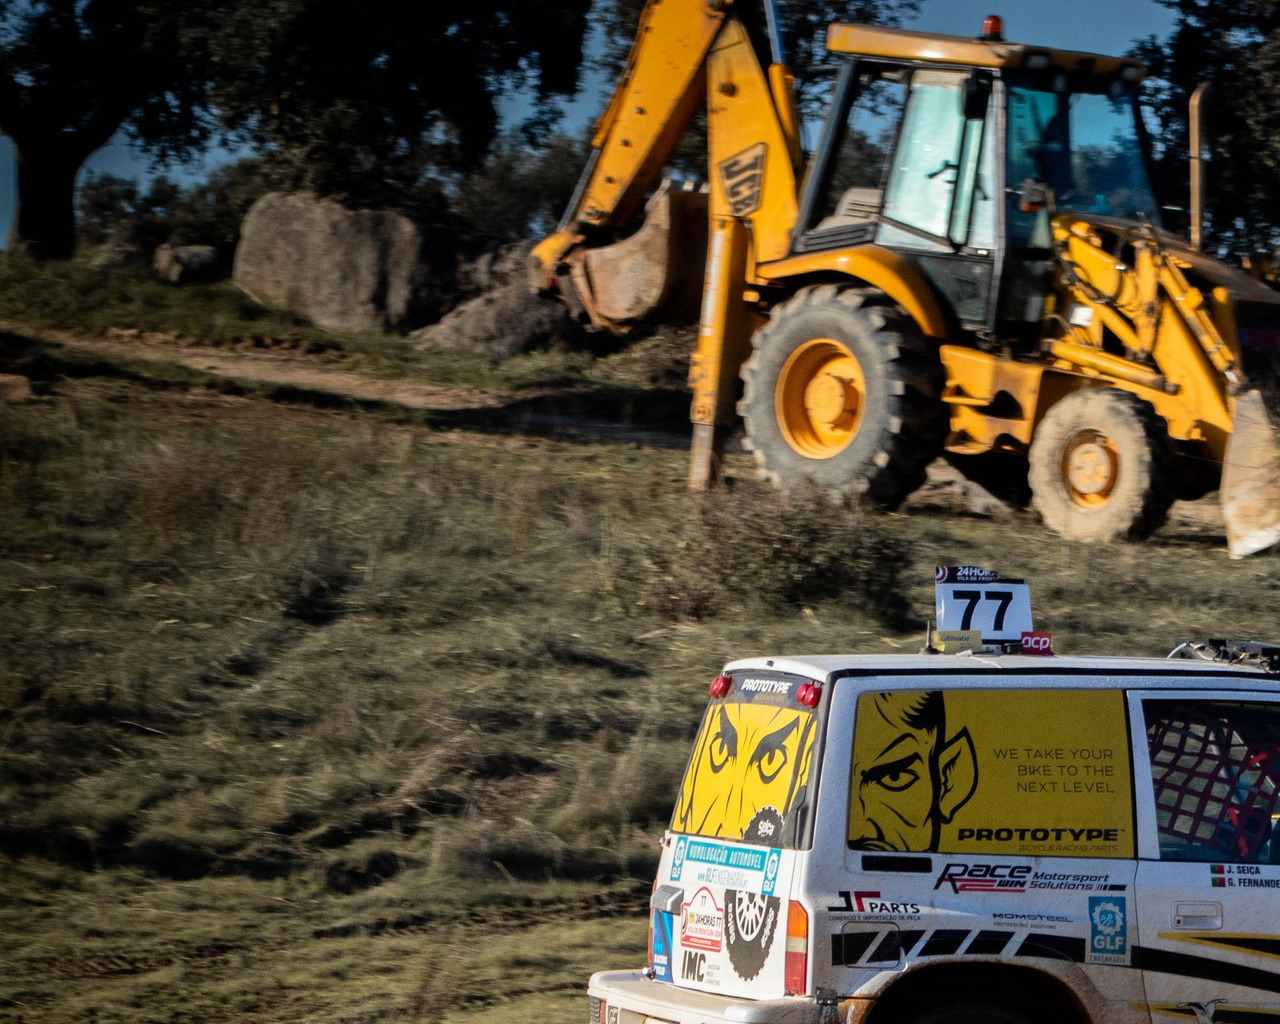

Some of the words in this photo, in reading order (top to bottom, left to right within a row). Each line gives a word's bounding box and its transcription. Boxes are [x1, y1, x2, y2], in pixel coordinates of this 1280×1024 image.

[723, 153, 764, 213] JCB
[953, 590, 1013, 631] 77
[1022, 637, 1050, 650] acp
[741, 678, 790, 694] PROTOTYPE
[993, 749, 1018, 760] WE
[1026, 749, 1064, 760] TAKE
[1071, 749, 1113, 760] YOUR
[1017, 765, 1051, 776] BIKE
[1057, 765, 1078, 776] TO
[1083, 765, 1114, 777] THE
[1017, 782, 1058, 793] NEXT
[1063, 782, 1115, 793] LEVEL
[957, 828, 1119, 842] PROTOTYPE
[1018, 844, 1054, 852] BICYCLE
[671, 866, 682, 878] GLF
[1227, 865, 1234, 874] J.
[1236, 865, 1261, 875] SEIÇA
[1032, 872, 1109, 883] Motorsport
[1228, 878, 1236, 887] G.
[763, 879, 774, 892] GLF
[996, 880, 1027, 888] WIN
[1029, 881, 1093, 891] Solutions
[869, 902, 920, 914] PARTS
[1093, 935, 1124, 950] GLF
[681, 950, 706, 982] IMC
